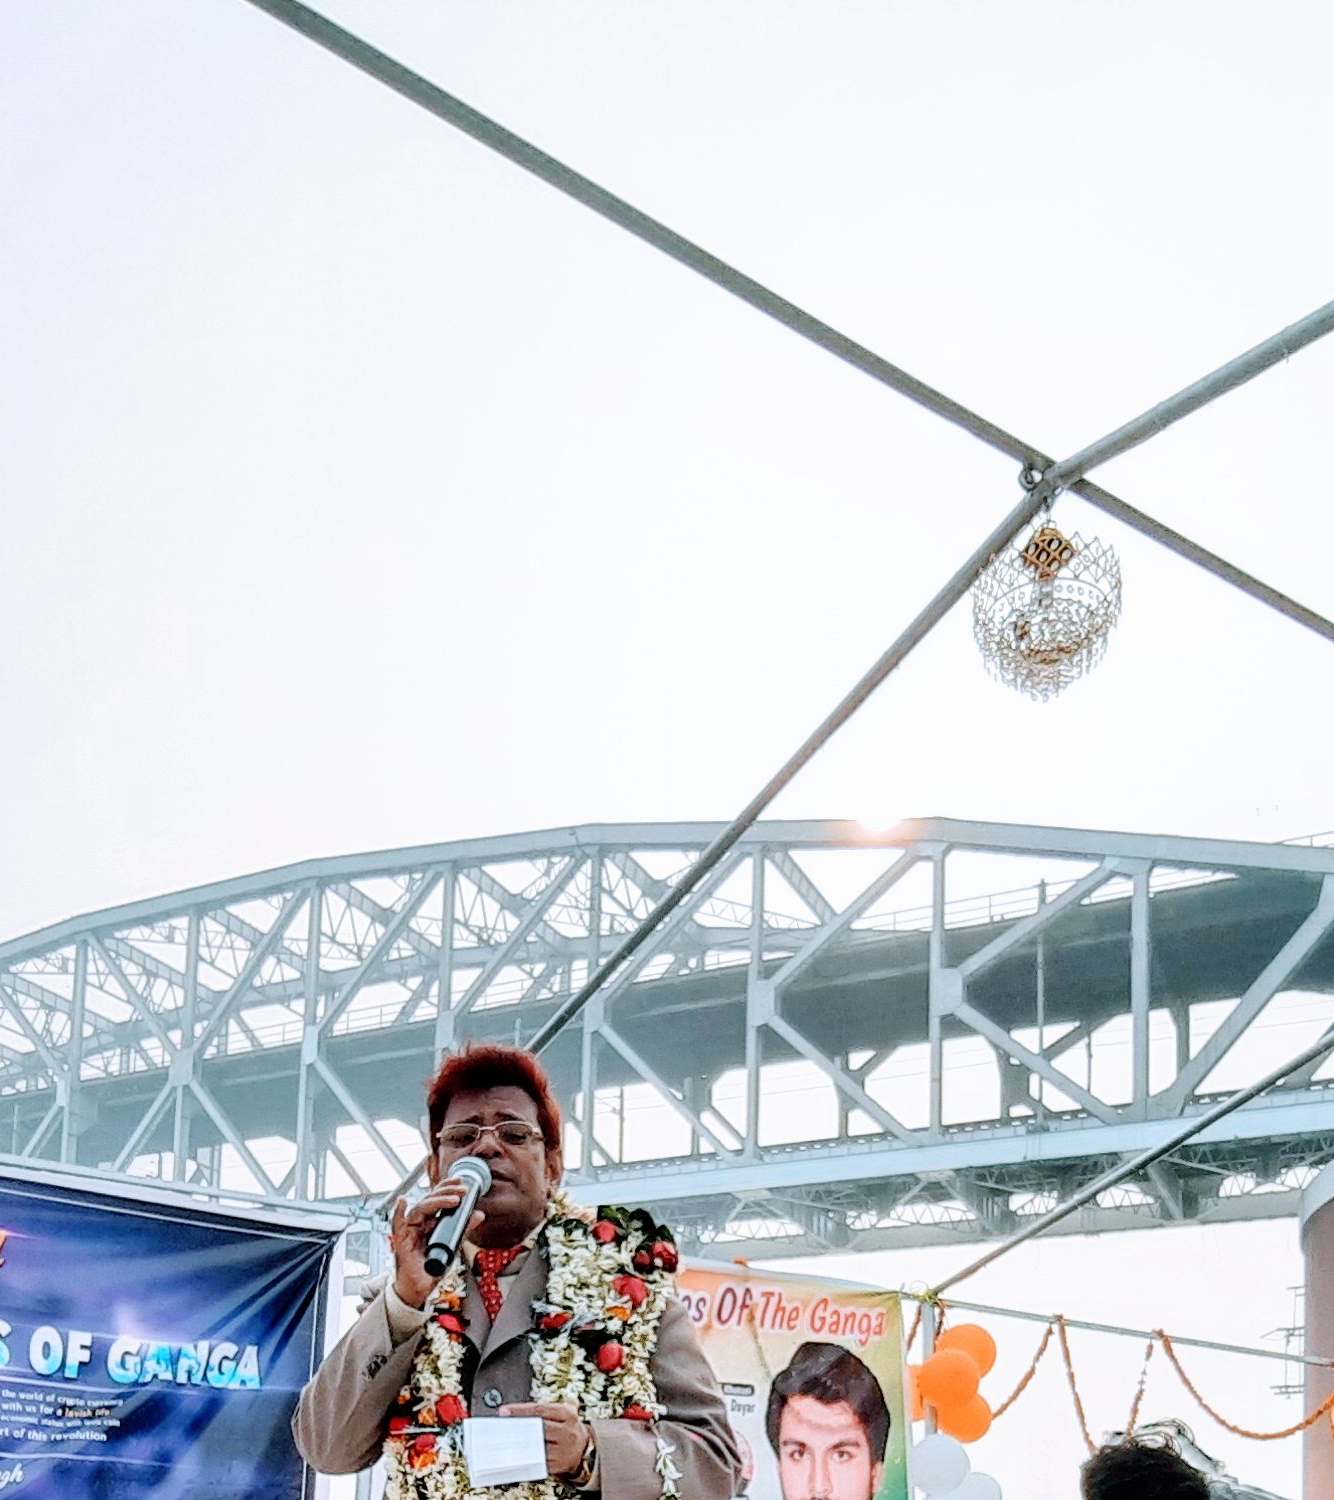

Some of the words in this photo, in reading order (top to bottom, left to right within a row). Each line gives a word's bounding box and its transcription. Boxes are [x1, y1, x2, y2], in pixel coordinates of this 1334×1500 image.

[716, 1287, 753, 1326] Of
[758, 1291, 799, 1331] The
[809, 1298, 885, 1345] Ganga
[29, 1325, 93, 1379] OF
[107, 1336, 262, 1390] GANGA
